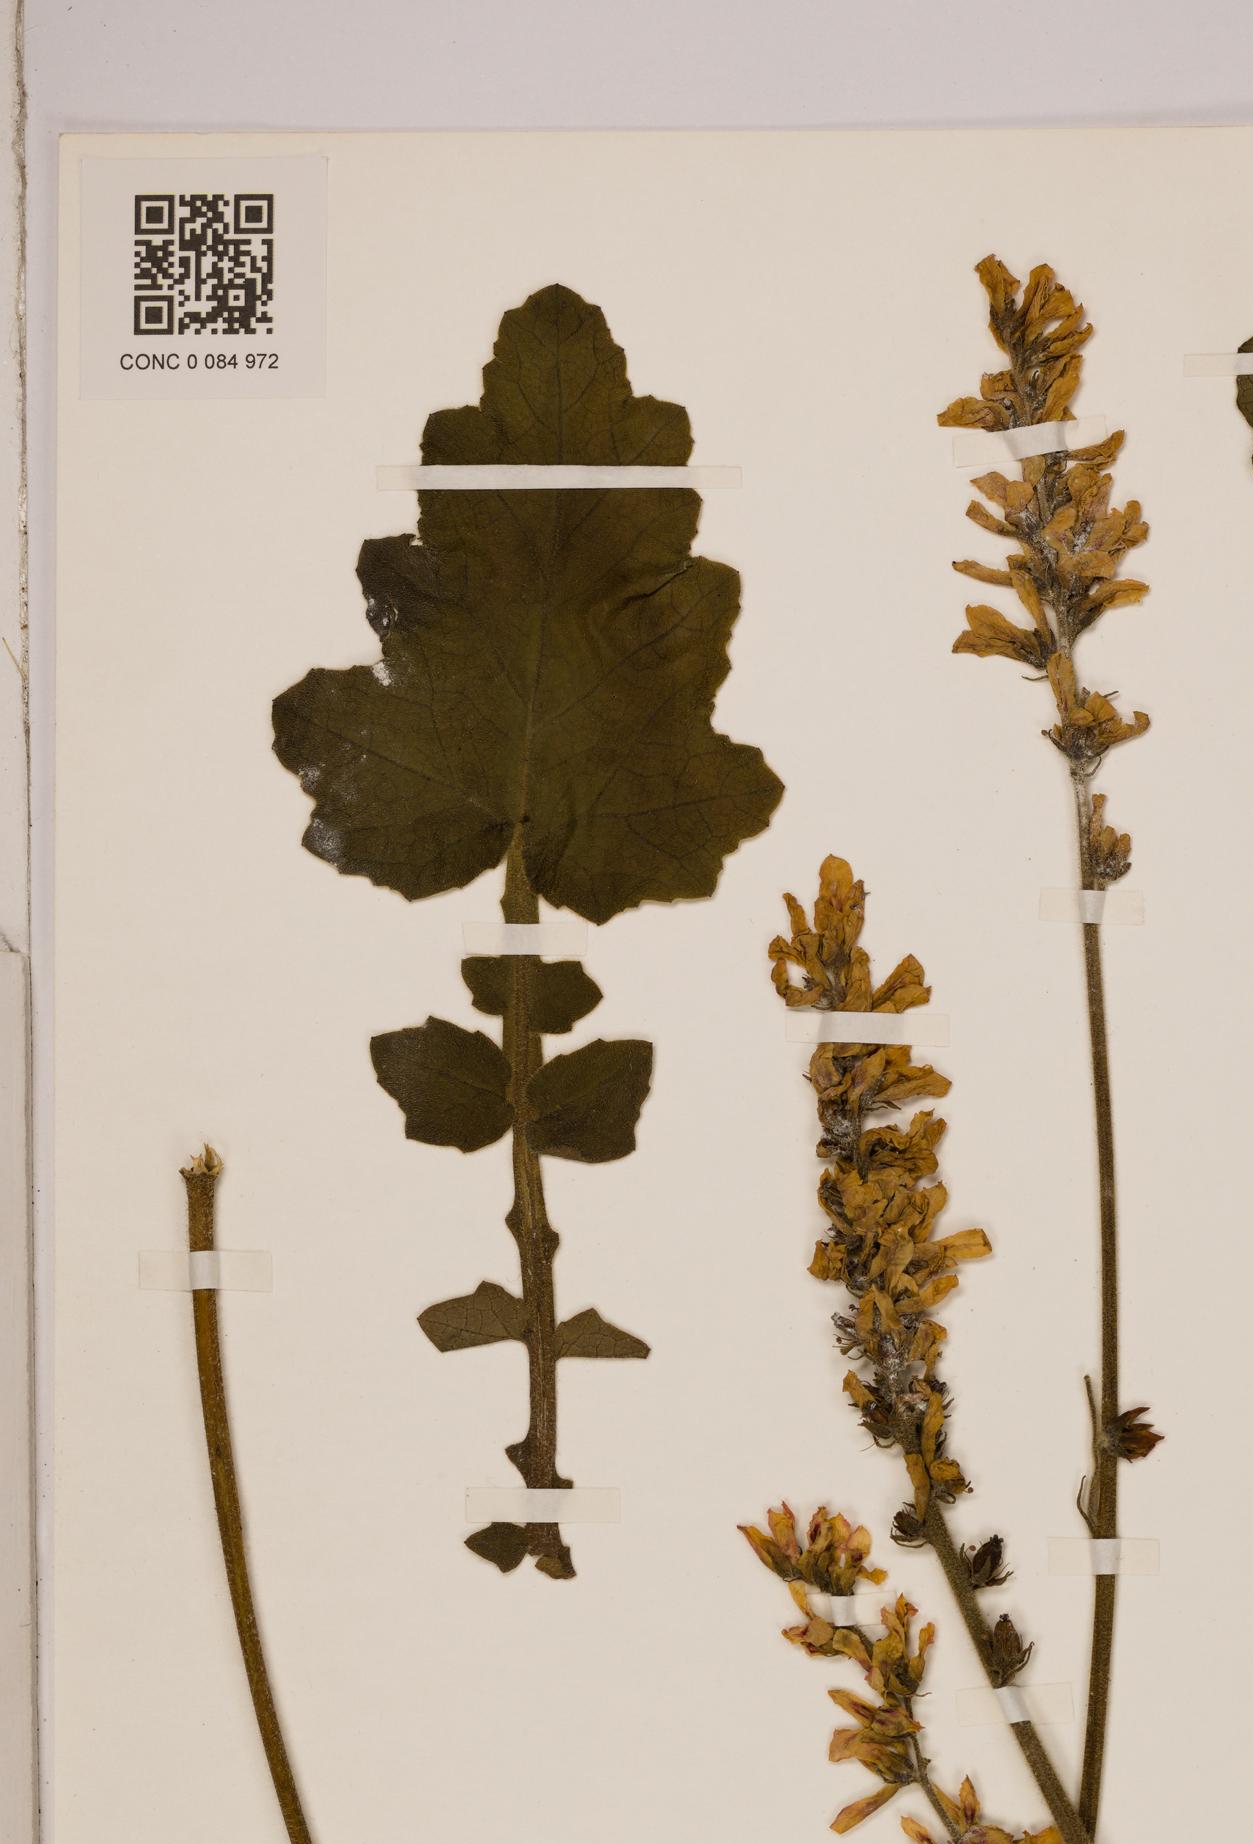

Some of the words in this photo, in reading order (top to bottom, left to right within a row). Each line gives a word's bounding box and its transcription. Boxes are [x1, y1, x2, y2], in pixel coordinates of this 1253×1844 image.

[120, 353, 180, 371] CONC
[187, 353, 198, 370] 0
[204, 353, 239, 370] 084
[245, 353, 279, 369] 972
